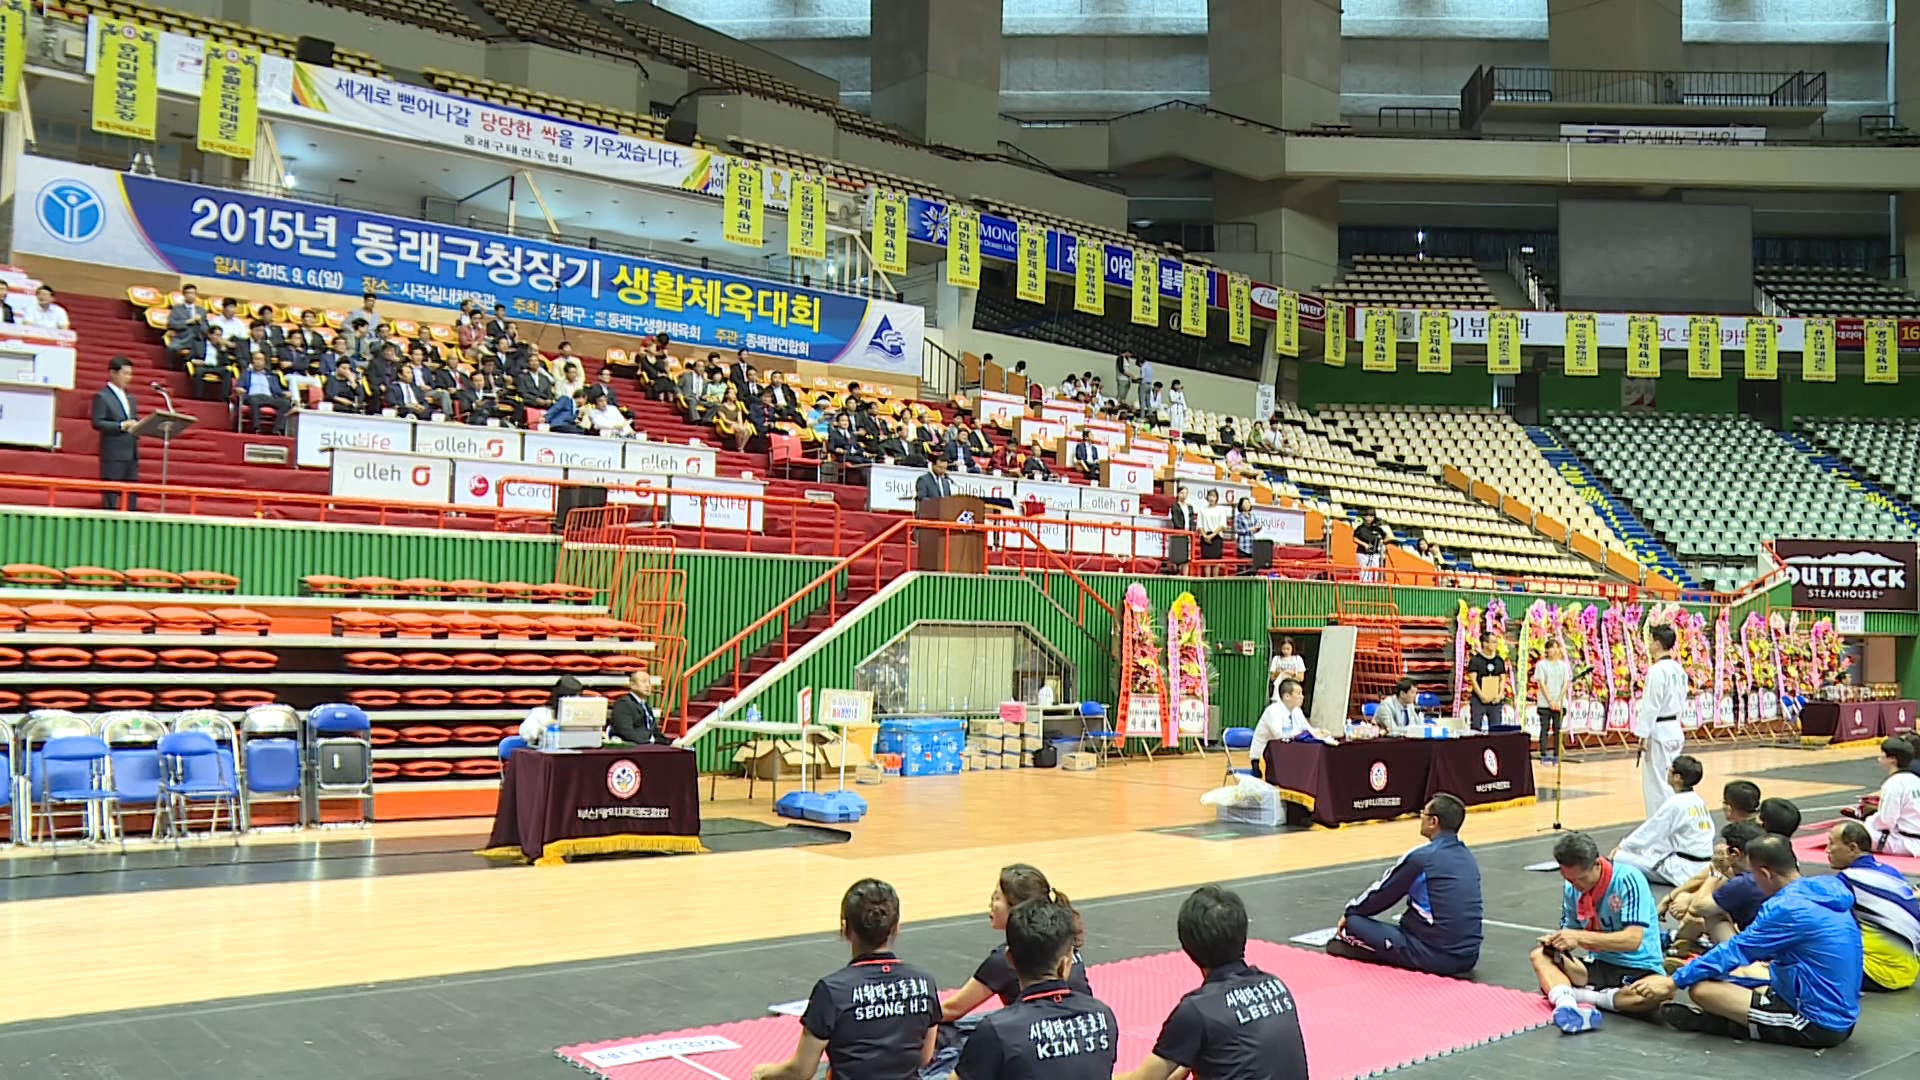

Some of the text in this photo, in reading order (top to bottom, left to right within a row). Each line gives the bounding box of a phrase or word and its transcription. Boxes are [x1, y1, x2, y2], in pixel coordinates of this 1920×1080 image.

[336, 77, 683, 168] 세계로 뻗어나갈 당당한 싹을 키우겠습니다.
[190, 198, 820, 333] 2015년 동래구청장기 생활체육대회
[214, 255, 246, 276] 일시
[362, 276, 391, 296] 장소
[512, 297, 540, 317] 주최
[550, 304, 586, 322] 동래구
[608, 313, 701, 341] 동래구생활체육회
[715, 327, 738, 346] 주관
[746, 333, 810, 357] 종목별연합회
[434, 436, 478, 455] olleh
[353, 463, 401, 482] olleh
[1092, 496, 1116, 512] olleh
[1785, 567, 1905, 589] OUTBACK
[1808, 589, 1878, 599] STEAKHOUSE
[855, 1000, 906, 1020] SEONG
[1236, 1002, 1270, 1024] LEE
[1037, 1039, 1080, 1059] KIM
